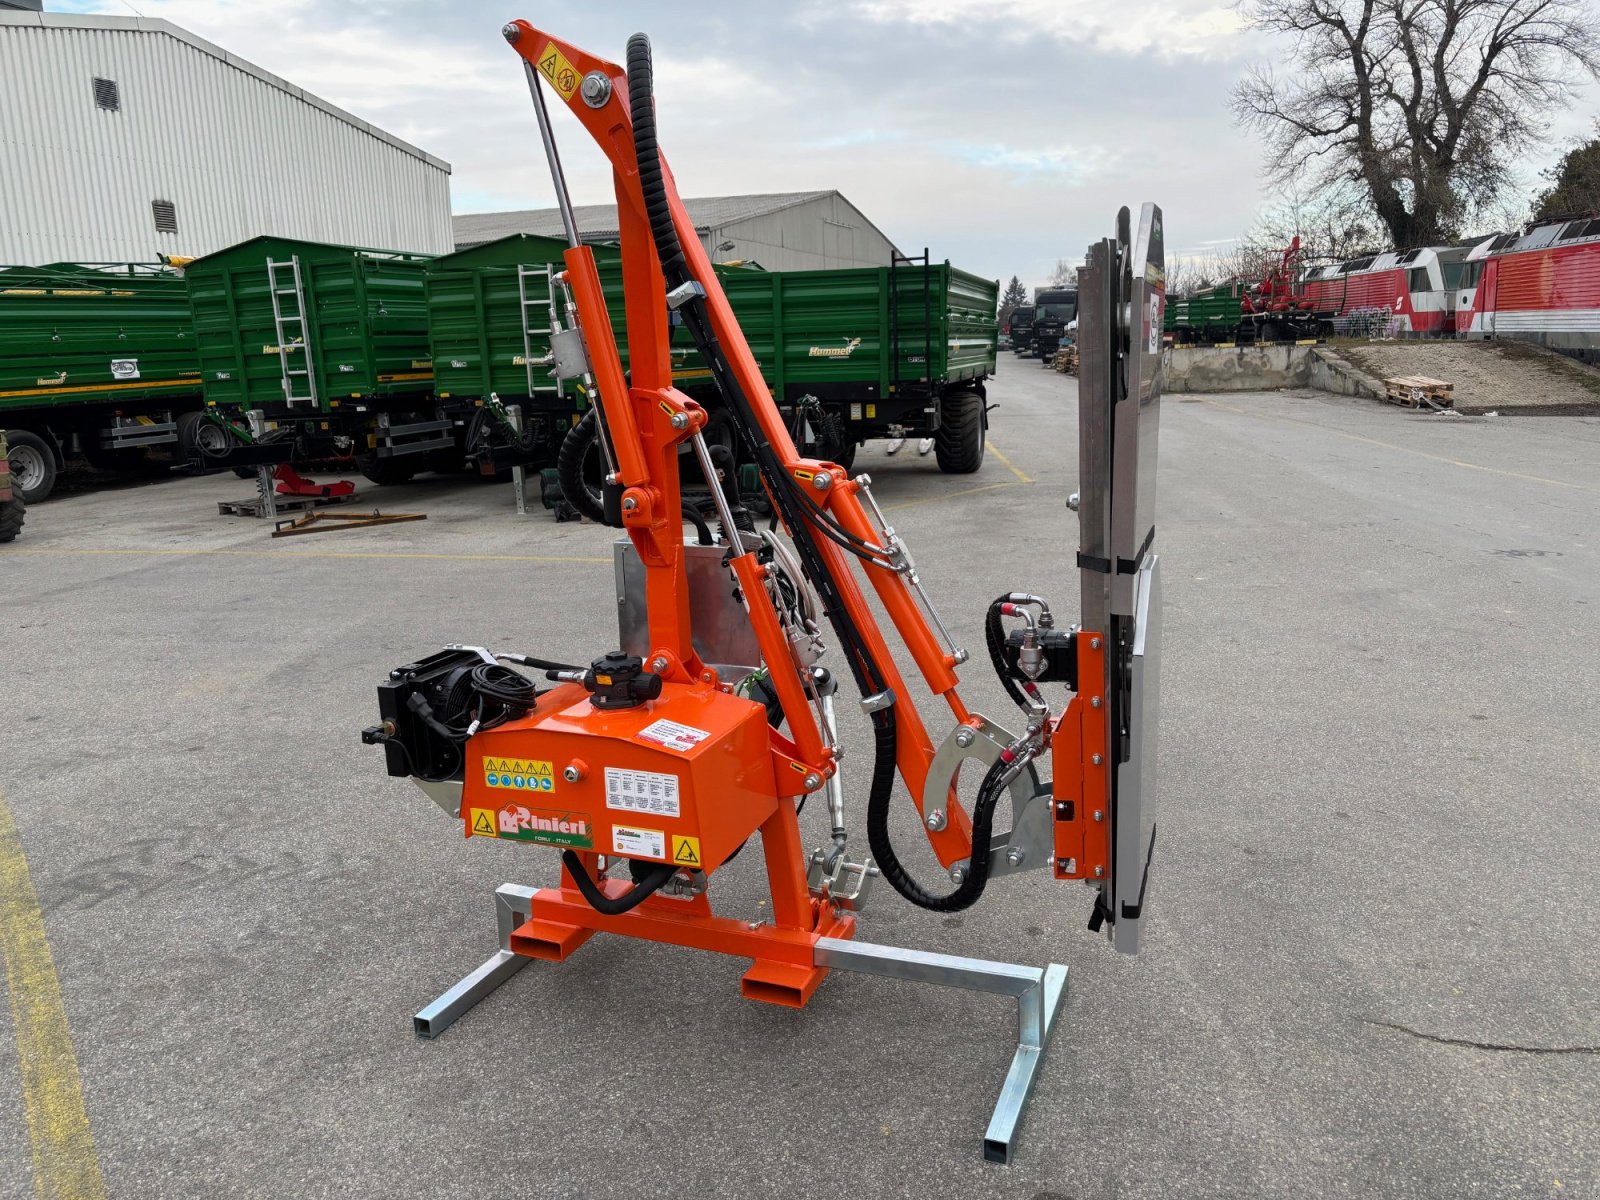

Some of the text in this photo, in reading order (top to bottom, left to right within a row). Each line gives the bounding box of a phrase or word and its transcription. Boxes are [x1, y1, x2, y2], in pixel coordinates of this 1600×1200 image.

[809, 346, 850, 356] Hummel
[513, 806, 586, 835] Rinieri
[534, 835, 551, 843] FORLI
[556, 837, 572, 845] ITALY
